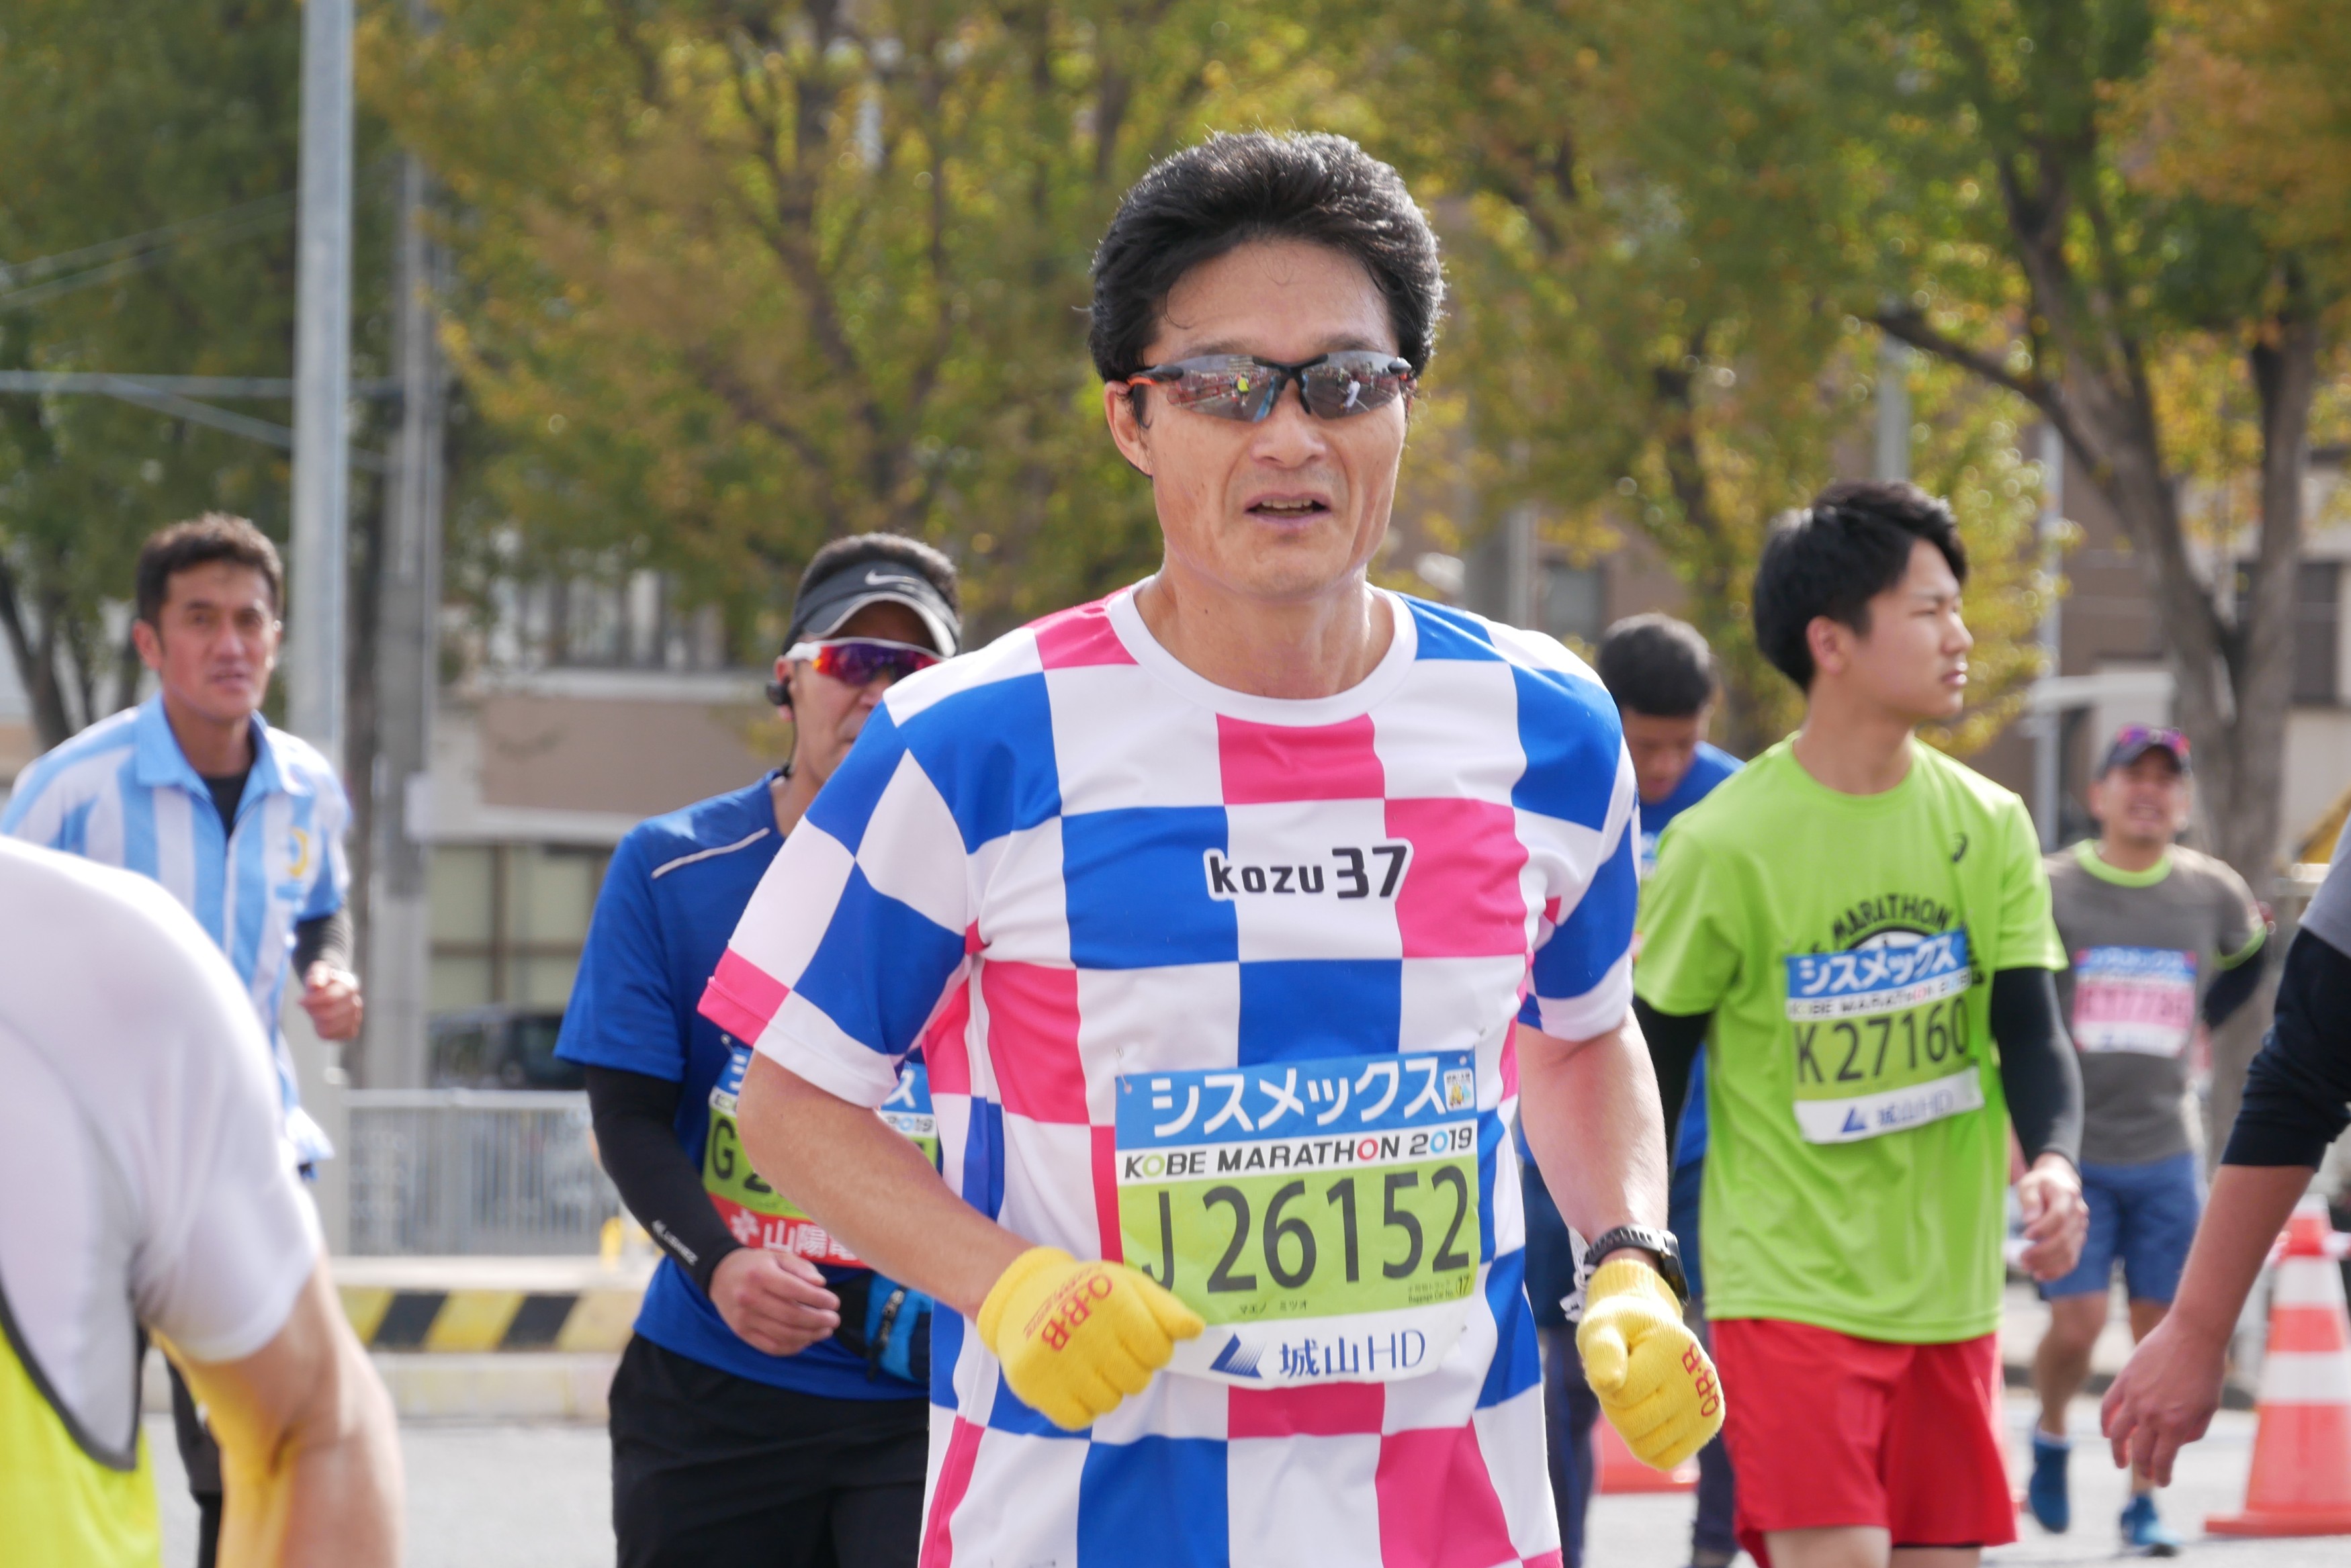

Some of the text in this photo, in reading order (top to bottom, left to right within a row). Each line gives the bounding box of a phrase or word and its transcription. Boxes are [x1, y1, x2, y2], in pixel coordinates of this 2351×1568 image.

[1210, 845, 1407, 898] kozu 37
[1833, 893, 1952, 943] MARATHON
[1799, 935, 1957, 995] シスメックス
[1151, 1058, 1446, 1138] シスメックス
[1124, 1127, 1472, 1180] KOBE MARATHON 2019
